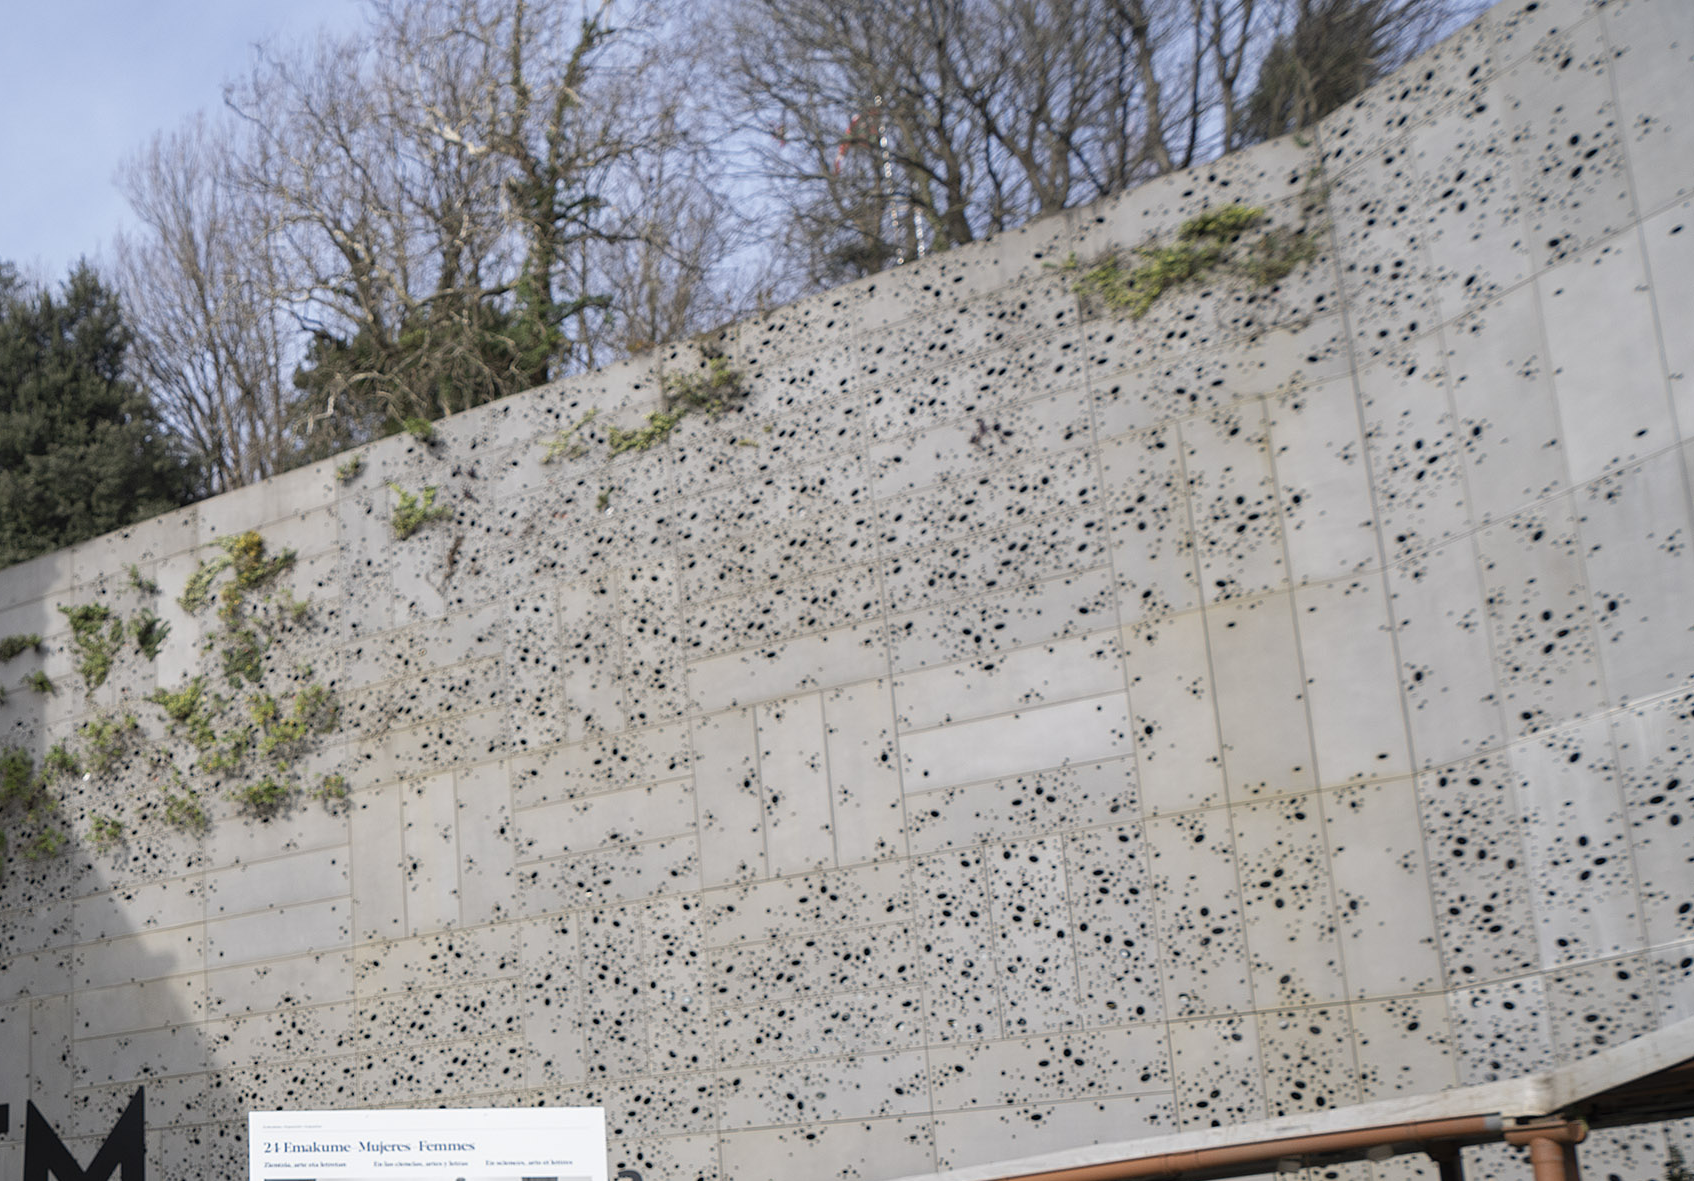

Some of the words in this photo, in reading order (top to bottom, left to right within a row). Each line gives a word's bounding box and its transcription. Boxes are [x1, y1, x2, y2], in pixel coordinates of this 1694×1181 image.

[284, 1141, 351, 1153] Emakume
[359, 1140, 411, 1154] Mujeres
[419, 1140, 475, 1152] Femmes
